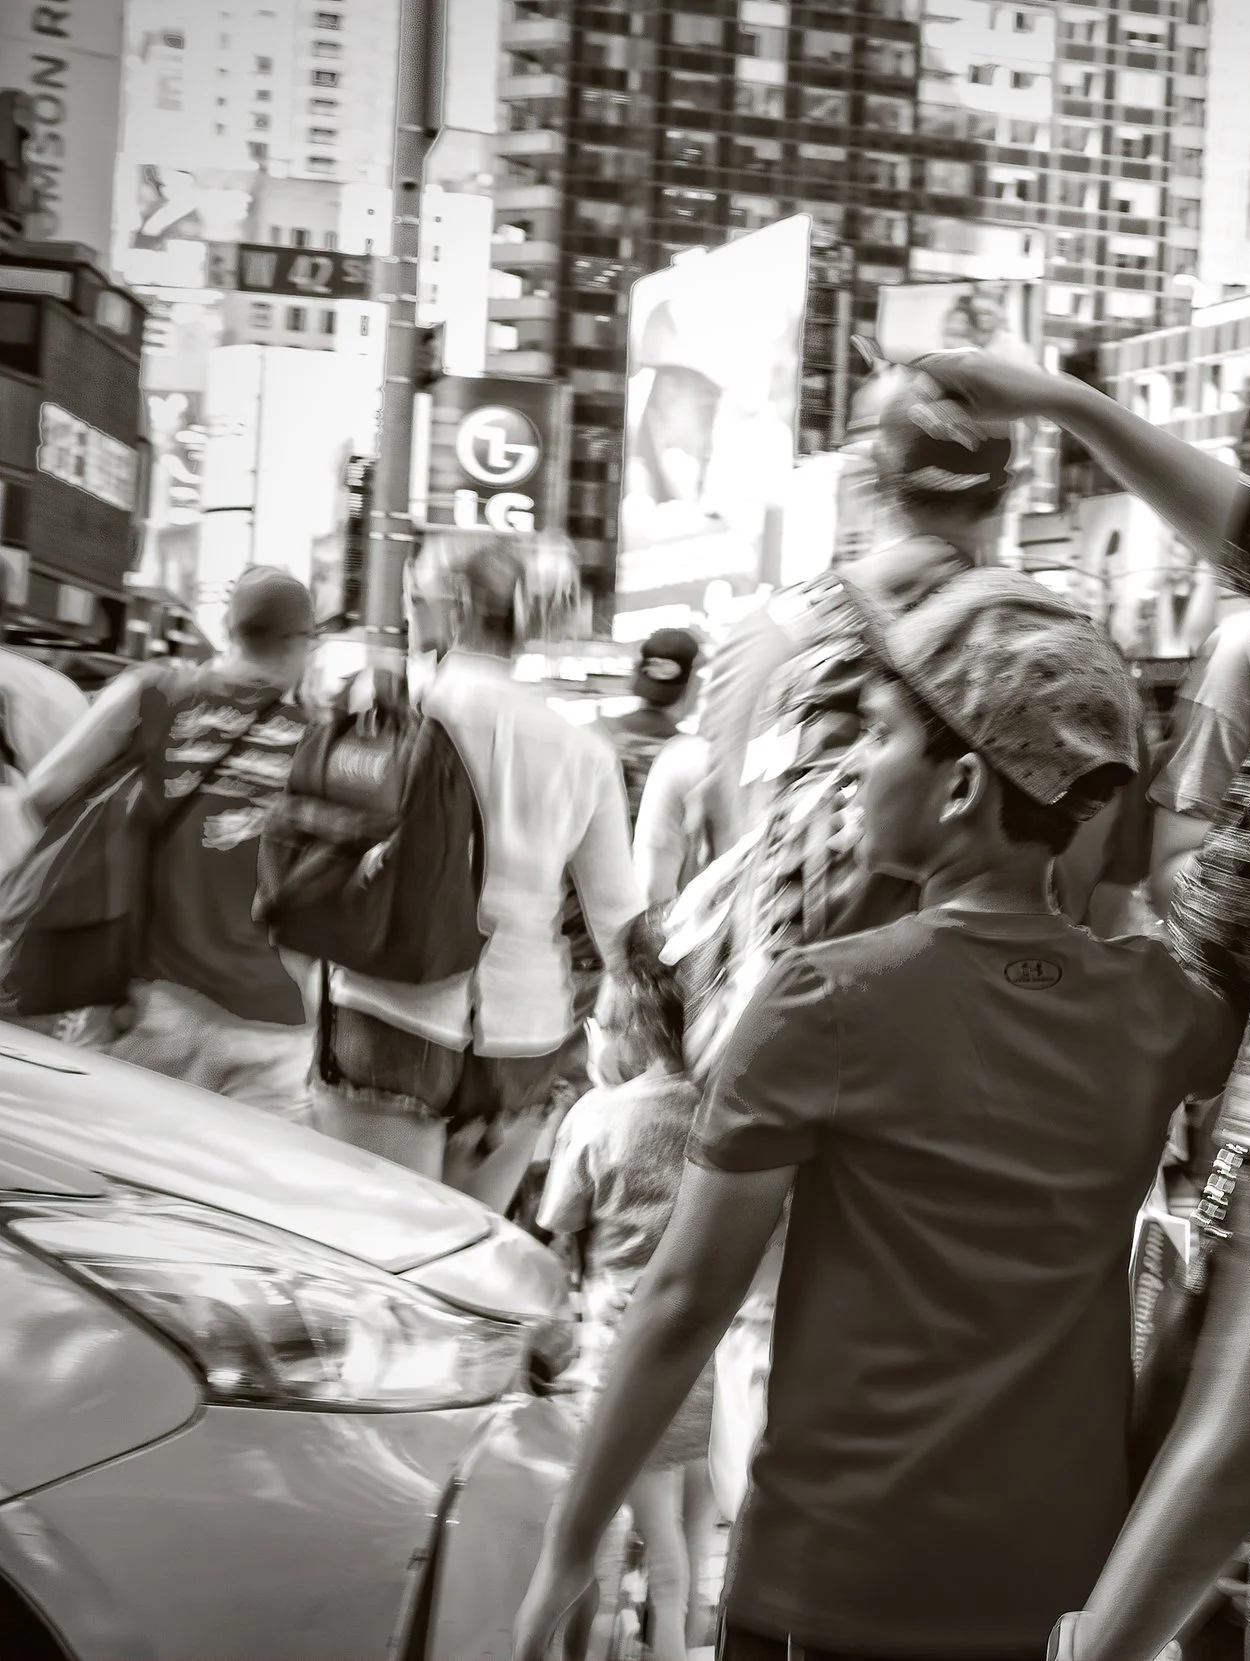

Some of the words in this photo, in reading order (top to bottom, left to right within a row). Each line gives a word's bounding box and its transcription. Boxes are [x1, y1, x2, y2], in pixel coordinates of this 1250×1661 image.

[31, 0, 71, 38] R
[287, 254, 334, 294] 42
[453, 489, 535, 532] LG
